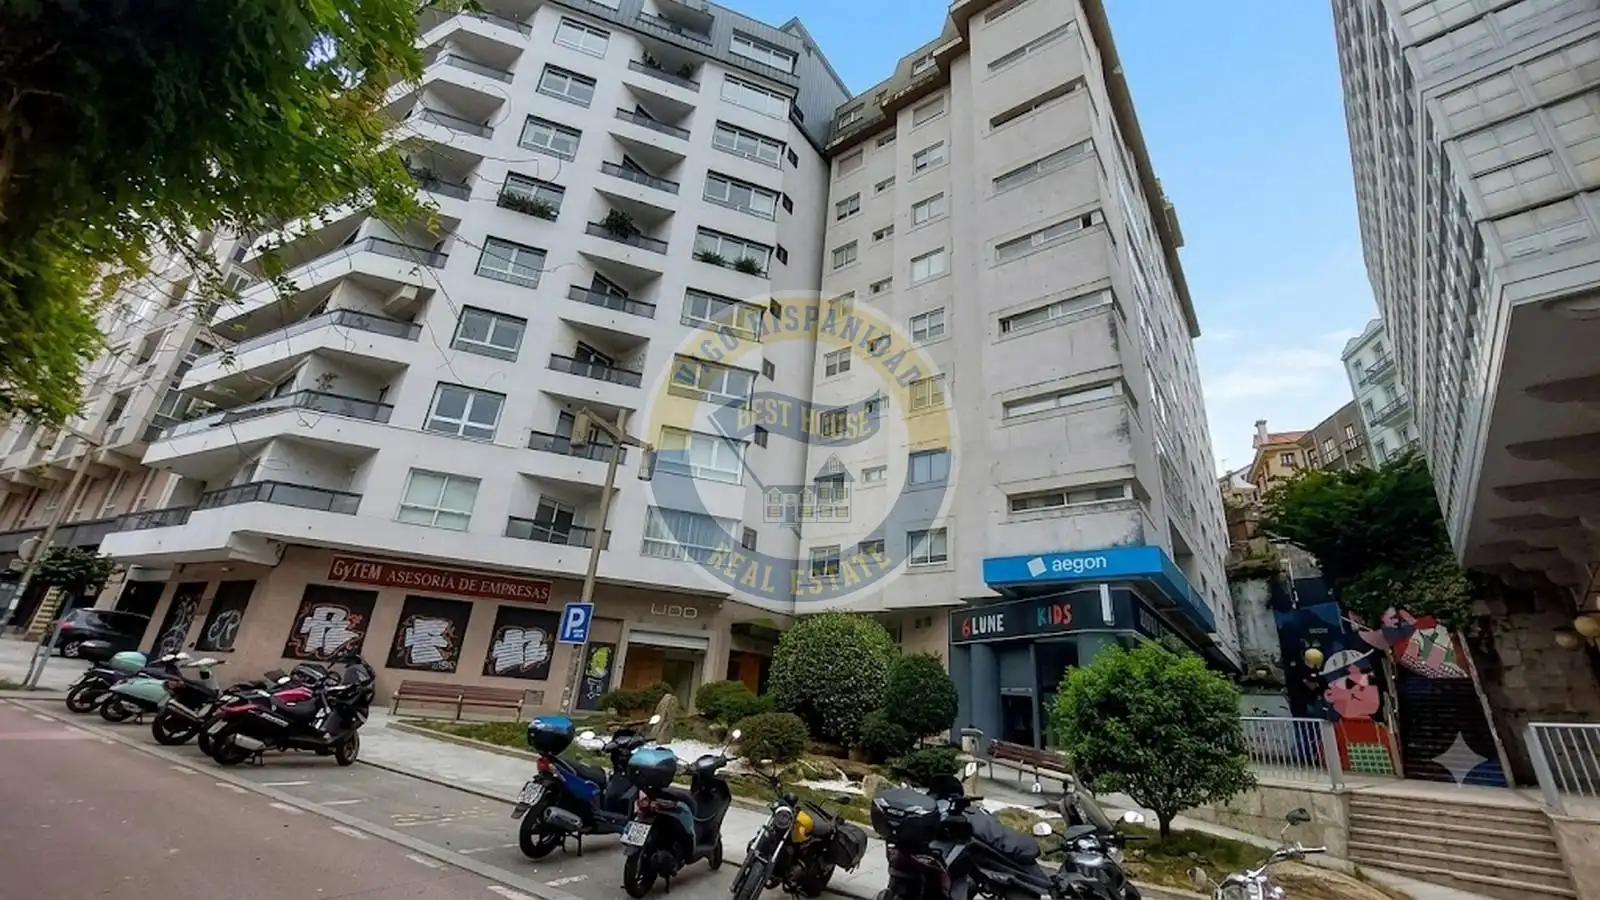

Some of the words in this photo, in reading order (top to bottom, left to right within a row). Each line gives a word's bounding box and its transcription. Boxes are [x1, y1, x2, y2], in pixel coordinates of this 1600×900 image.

[1052, 556, 1107, 573] aegon
[386, 570, 455, 589] ASESORÍA
[458, 578, 478, 592] DE
[480, 581, 548, 600] EMPRESAS
[564, 607, 586, 638] P
[1037, 604, 1072, 627] KIDS
